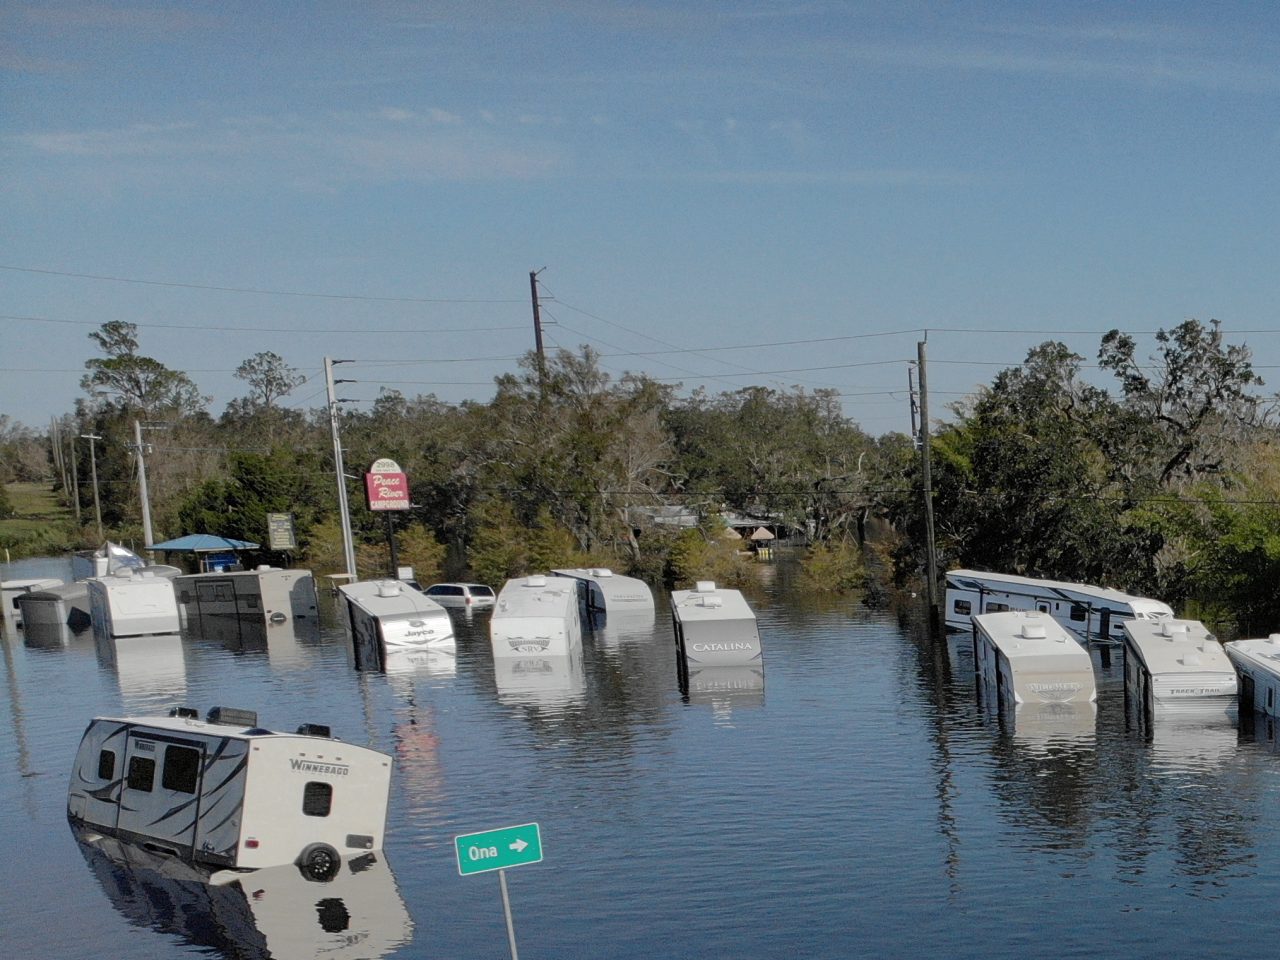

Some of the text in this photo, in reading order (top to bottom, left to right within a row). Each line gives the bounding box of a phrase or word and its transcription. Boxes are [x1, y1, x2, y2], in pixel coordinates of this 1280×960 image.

[373, 475, 400, 487] Peace
[378, 487, 403, 498] River
[404, 629, 434, 637] Jayco
[693, 642, 752, 652] CATALINA
[289, 758, 349, 775] WINNEBAGO
[468, 846, 498, 861] Ona
